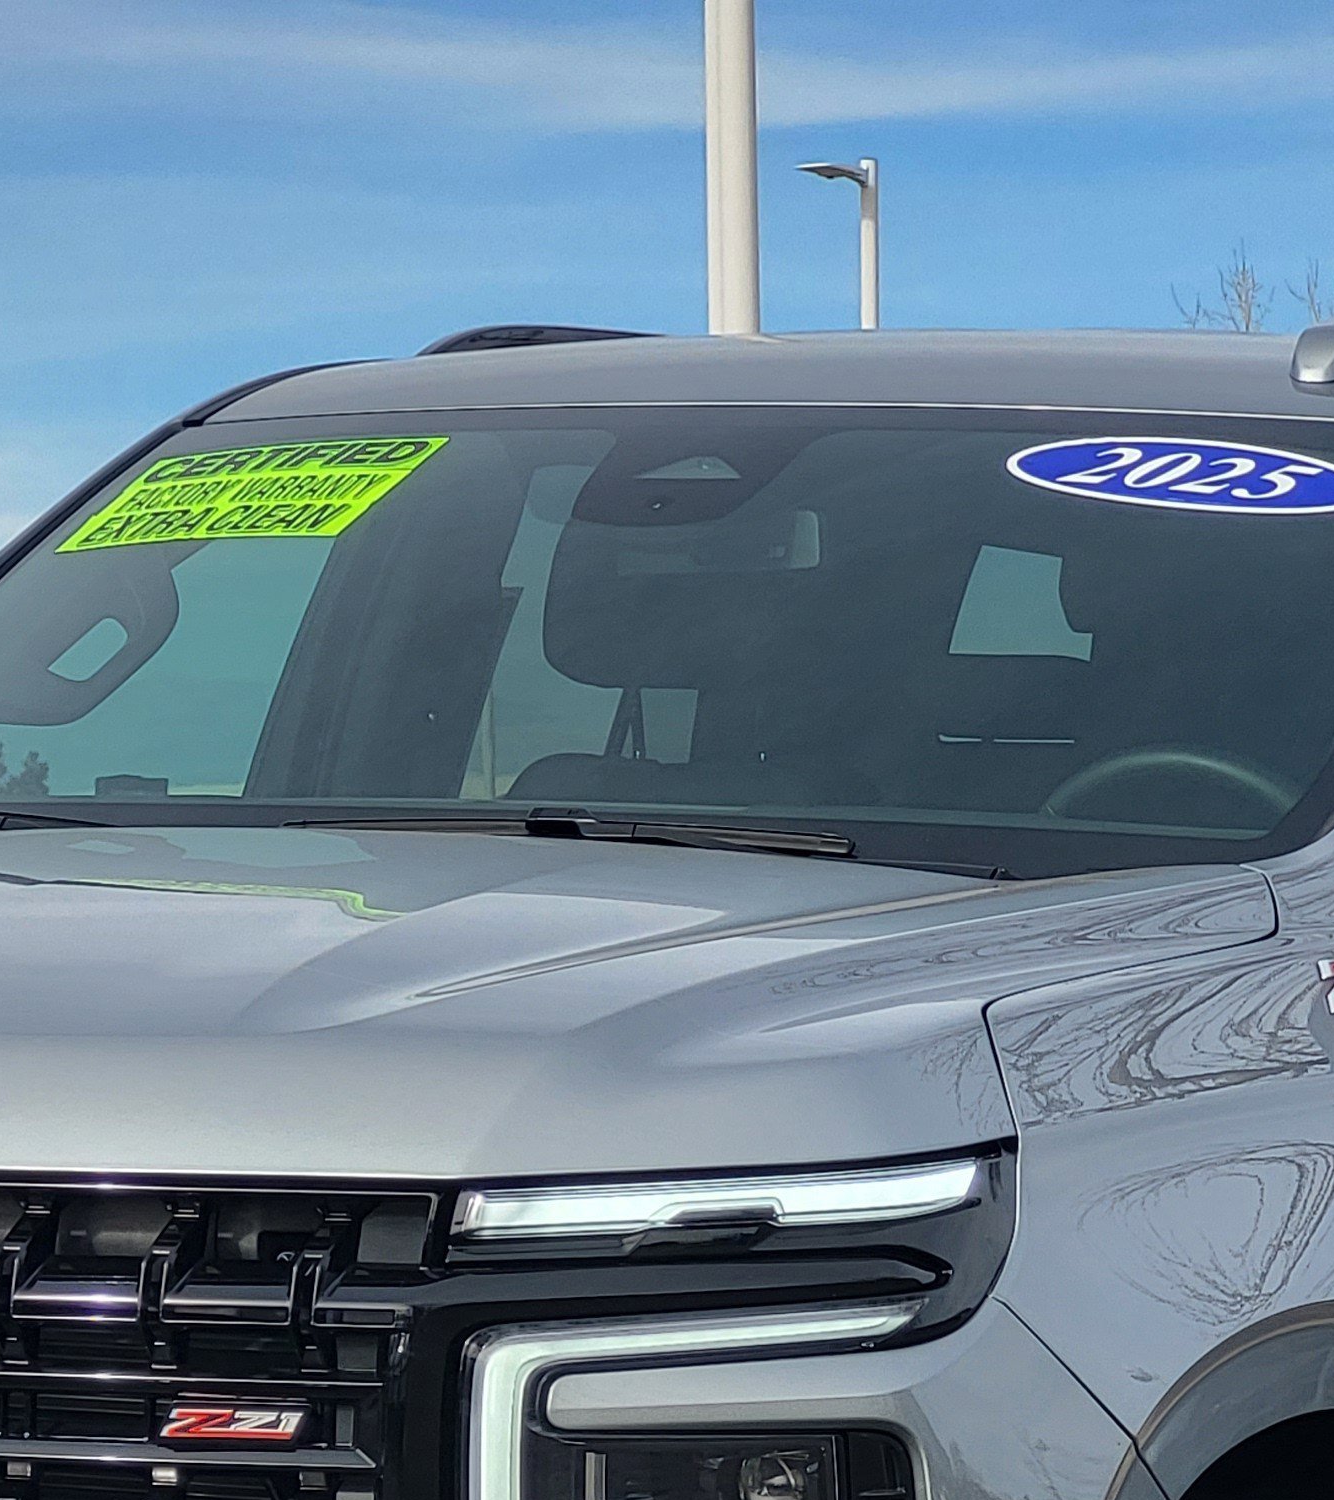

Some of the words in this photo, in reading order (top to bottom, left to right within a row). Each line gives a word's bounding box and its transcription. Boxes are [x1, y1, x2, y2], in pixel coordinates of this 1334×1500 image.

[143, 441, 432, 482] CERTIFIED
[1056, 446, 1324, 499] 2025
[116, 479, 239, 513] FACTORY
[228, 473, 391, 502] WARRANTY
[77, 506, 219, 546] EXTRA
[205, 503, 353, 532] CLEAN
[160, 1408, 304, 1440] Z71
